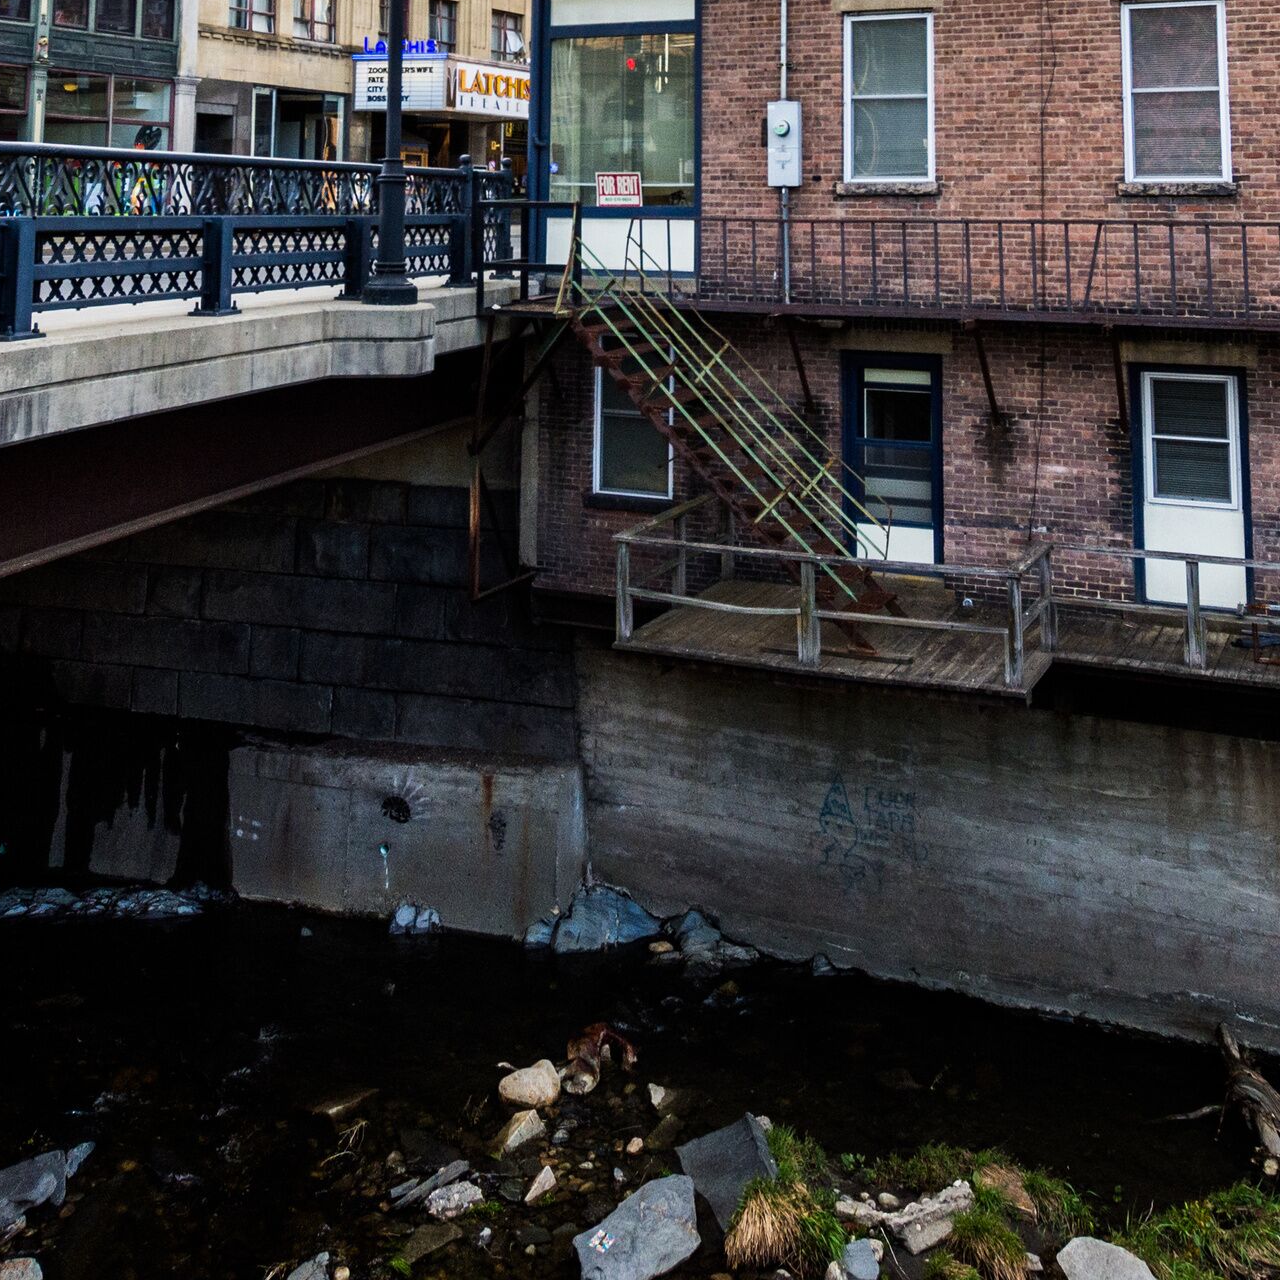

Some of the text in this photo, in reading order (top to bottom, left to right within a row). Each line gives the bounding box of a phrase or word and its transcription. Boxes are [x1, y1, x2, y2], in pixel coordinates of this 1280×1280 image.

[363, 36, 436, 54] LACHIS
[458, 68, 531, 102] LATCHIS
[599, 175, 638, 195] FOR RENT
